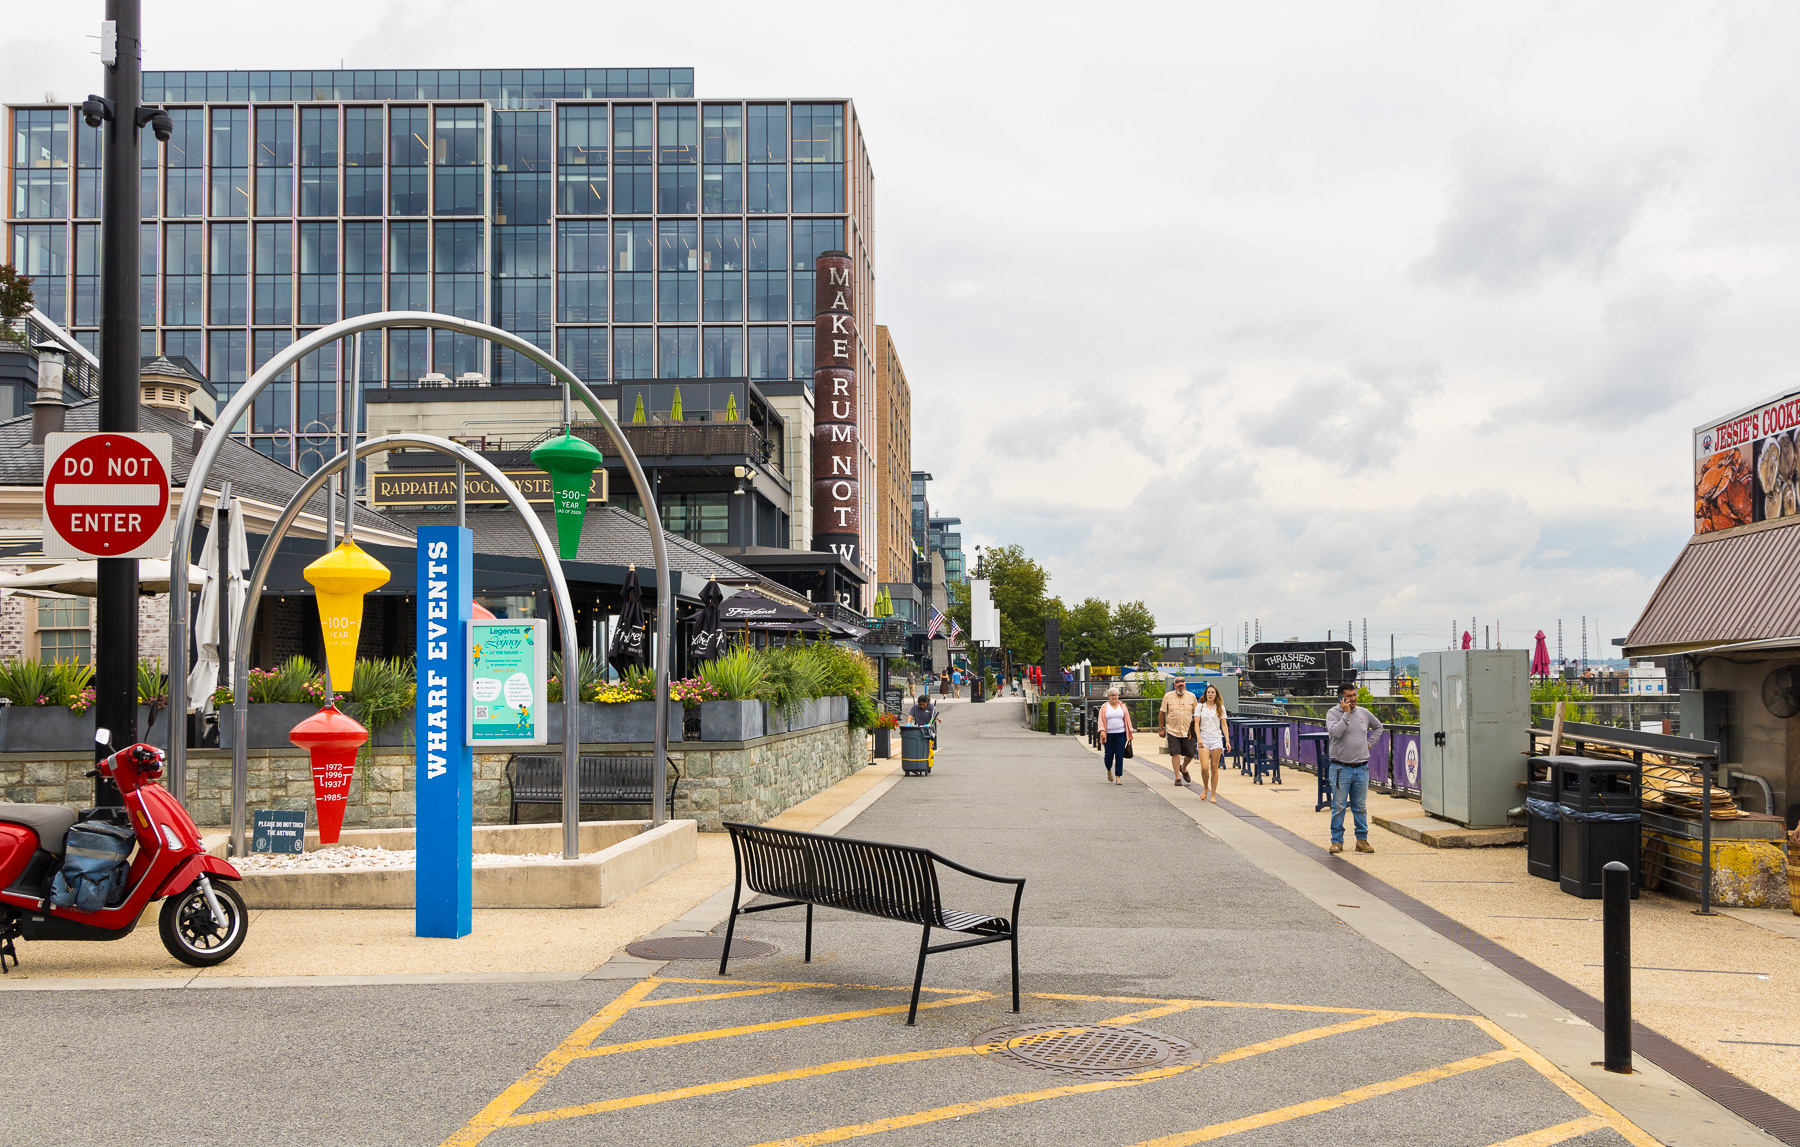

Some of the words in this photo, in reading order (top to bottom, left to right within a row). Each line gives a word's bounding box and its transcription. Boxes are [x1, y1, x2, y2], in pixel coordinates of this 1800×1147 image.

[829, 267, 850, 359] MAKE
[831, 377, 851, 443] RUM
[1714, 413, 1759, 452] JESSIE'S
[64, 457, 94, 477] DO
[107, 457, 153, 477] NOT
[561, 490, 580, 500] 500
[831, 455, 852, 527] NOT
[561, 501, 580, 509] YEAR
[71, 513, 142, 532] ENTER
[428, 540, 448, 661] EVENTS
[726, 607, 777, 618] Freixenet
[328, 617, 349, 629] 100
[490, 627, 521, 636] Legends
[485, 635, 522, 650] Legacy
[1264, 653, 1316, 666] THRASHER'S
[1280, 662, 1301, 670] RUM
[428, 669, 447, 780] WHARF
[325, 763, 343, 771] 1972
[325, 771, 343, 779] 1996
[324, 780, 342, 788] 1937
[324, 793, 342, 801] 1985
[258, 820, 276, 828] PLEASE
